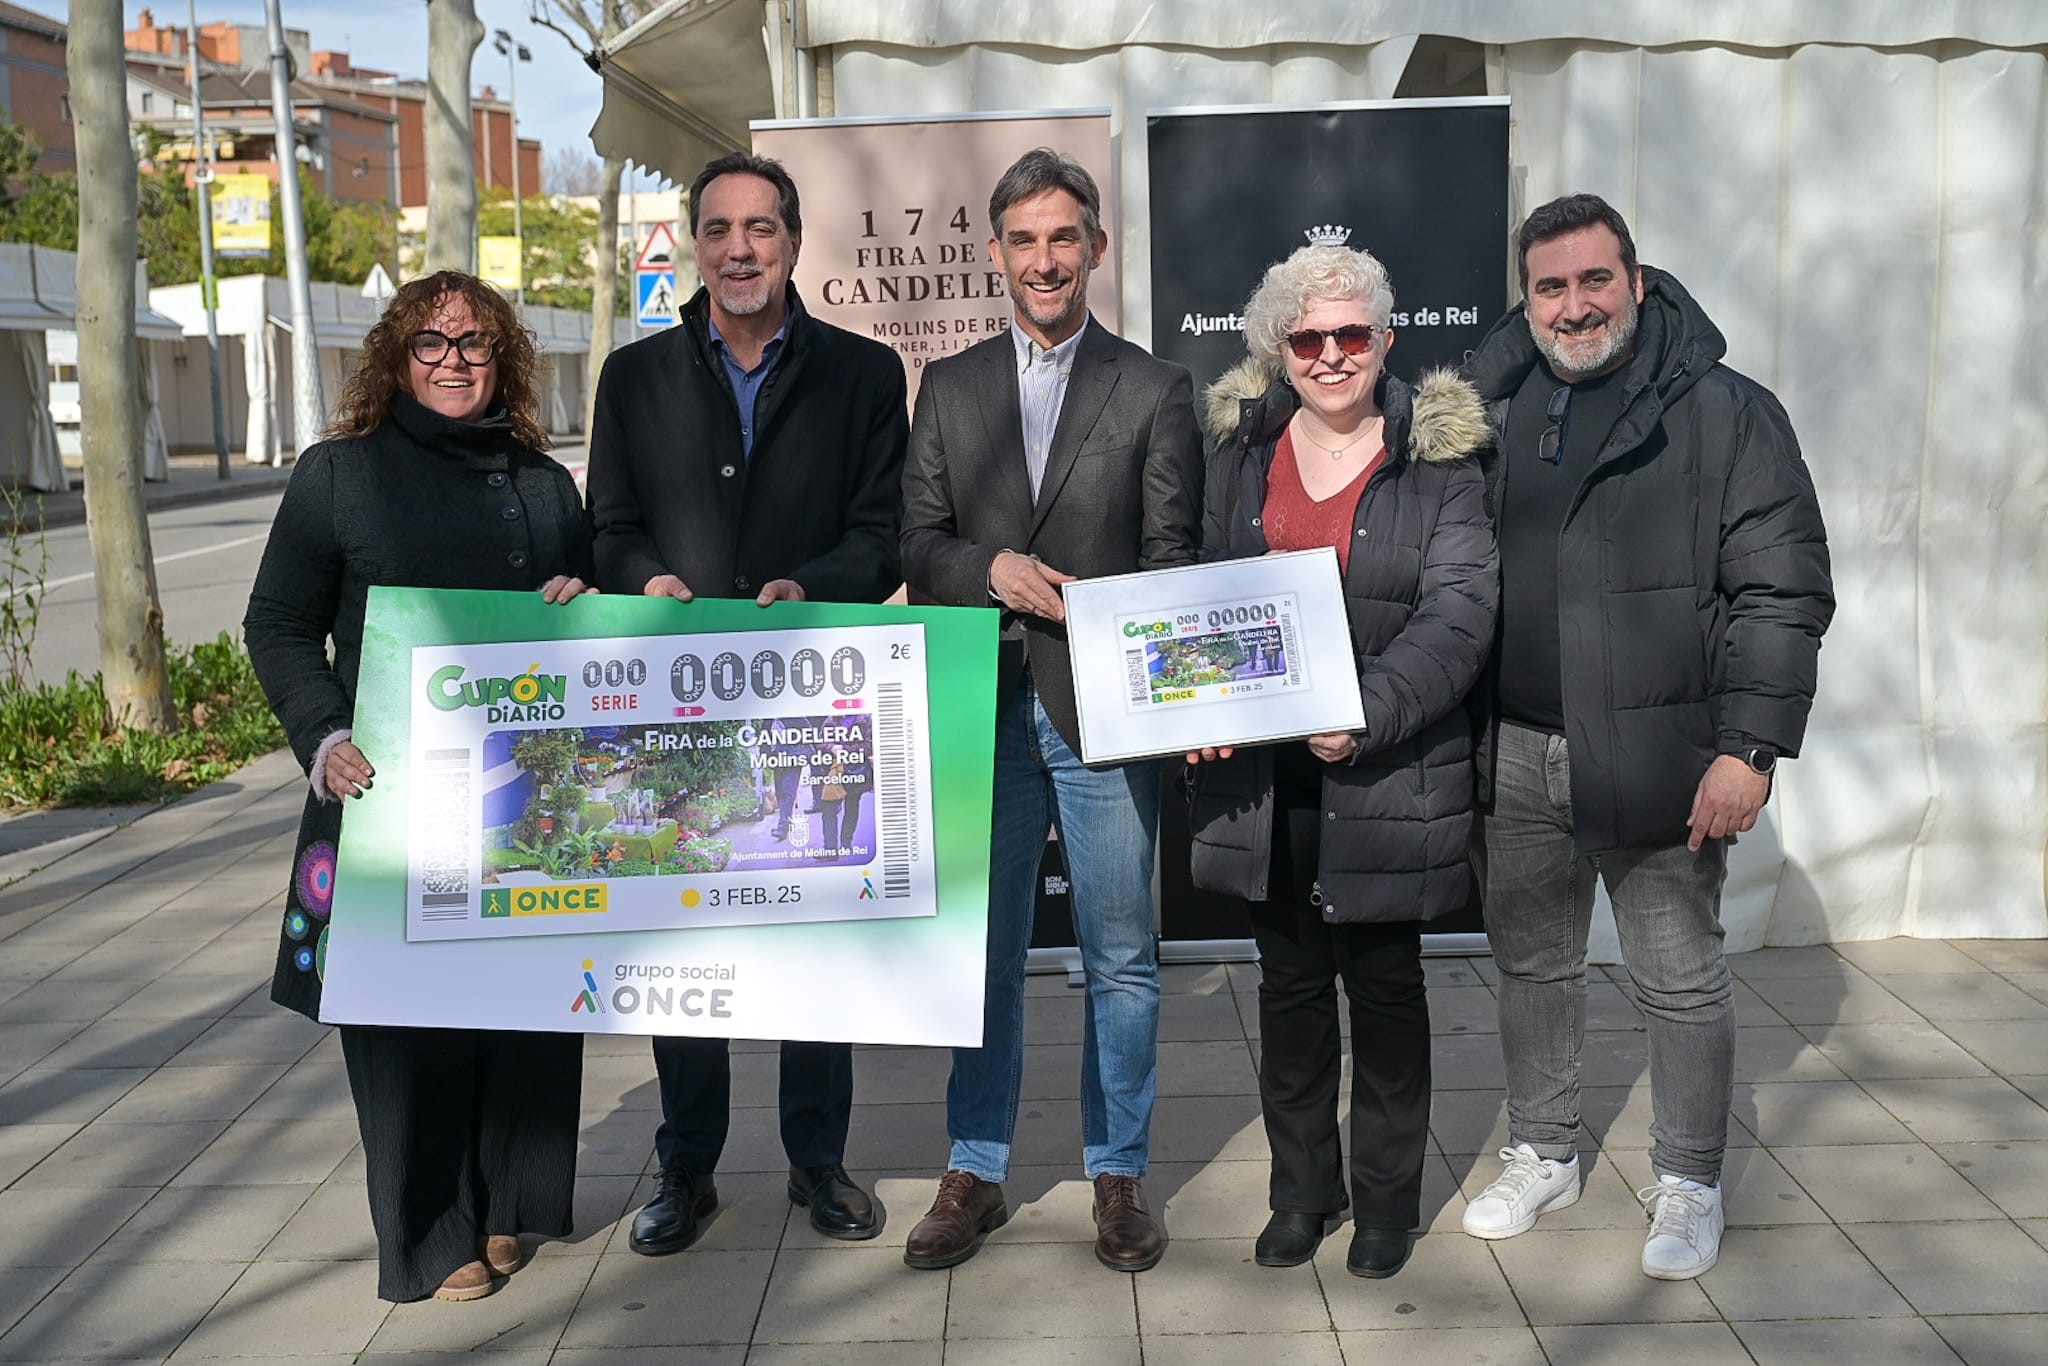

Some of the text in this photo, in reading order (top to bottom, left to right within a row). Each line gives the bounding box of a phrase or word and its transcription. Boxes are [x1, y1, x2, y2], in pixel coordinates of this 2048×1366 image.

[856, 243, 975, 268] FIRA DE
[822, 272, 1005, 306] CANDELE
[873, 317, 1012, 337] MOLINS DE RE
[1180, 313, 1246, 336] Ajunta
[1414, 308, 1440, 325] de
[1446, 307, 1477, 325] Rei
[891, 340, 934, 353] ENER,
[1207, 603, 1277, 627] 00000
[891, 644, 911, 659] 2€
[583, 658, 647, 688] 000
[671, 646, 866, 703] 00000
[426, 663, 567, 711] CUPÓN
[1164, 690, 1194, 701] ONCE
[592, 694, 637, 711] SERIE
[685, 707, 691, 715] R
[644, 726, 863, 750] FIRA de la CANDELERA
[750, 748, 864, 769] Molins de Rei
[802, 773, 865, 786] Barcelona
[732, 846, 868, 862] Ajuntament de Molins de Rei
[517, 888, 600, 911] ONCE
[709, 885, 801, 907] 3 FEB. 25
[615, 963, 736, 982] grupo social
[612, 985, 734, 1018] ONCE
